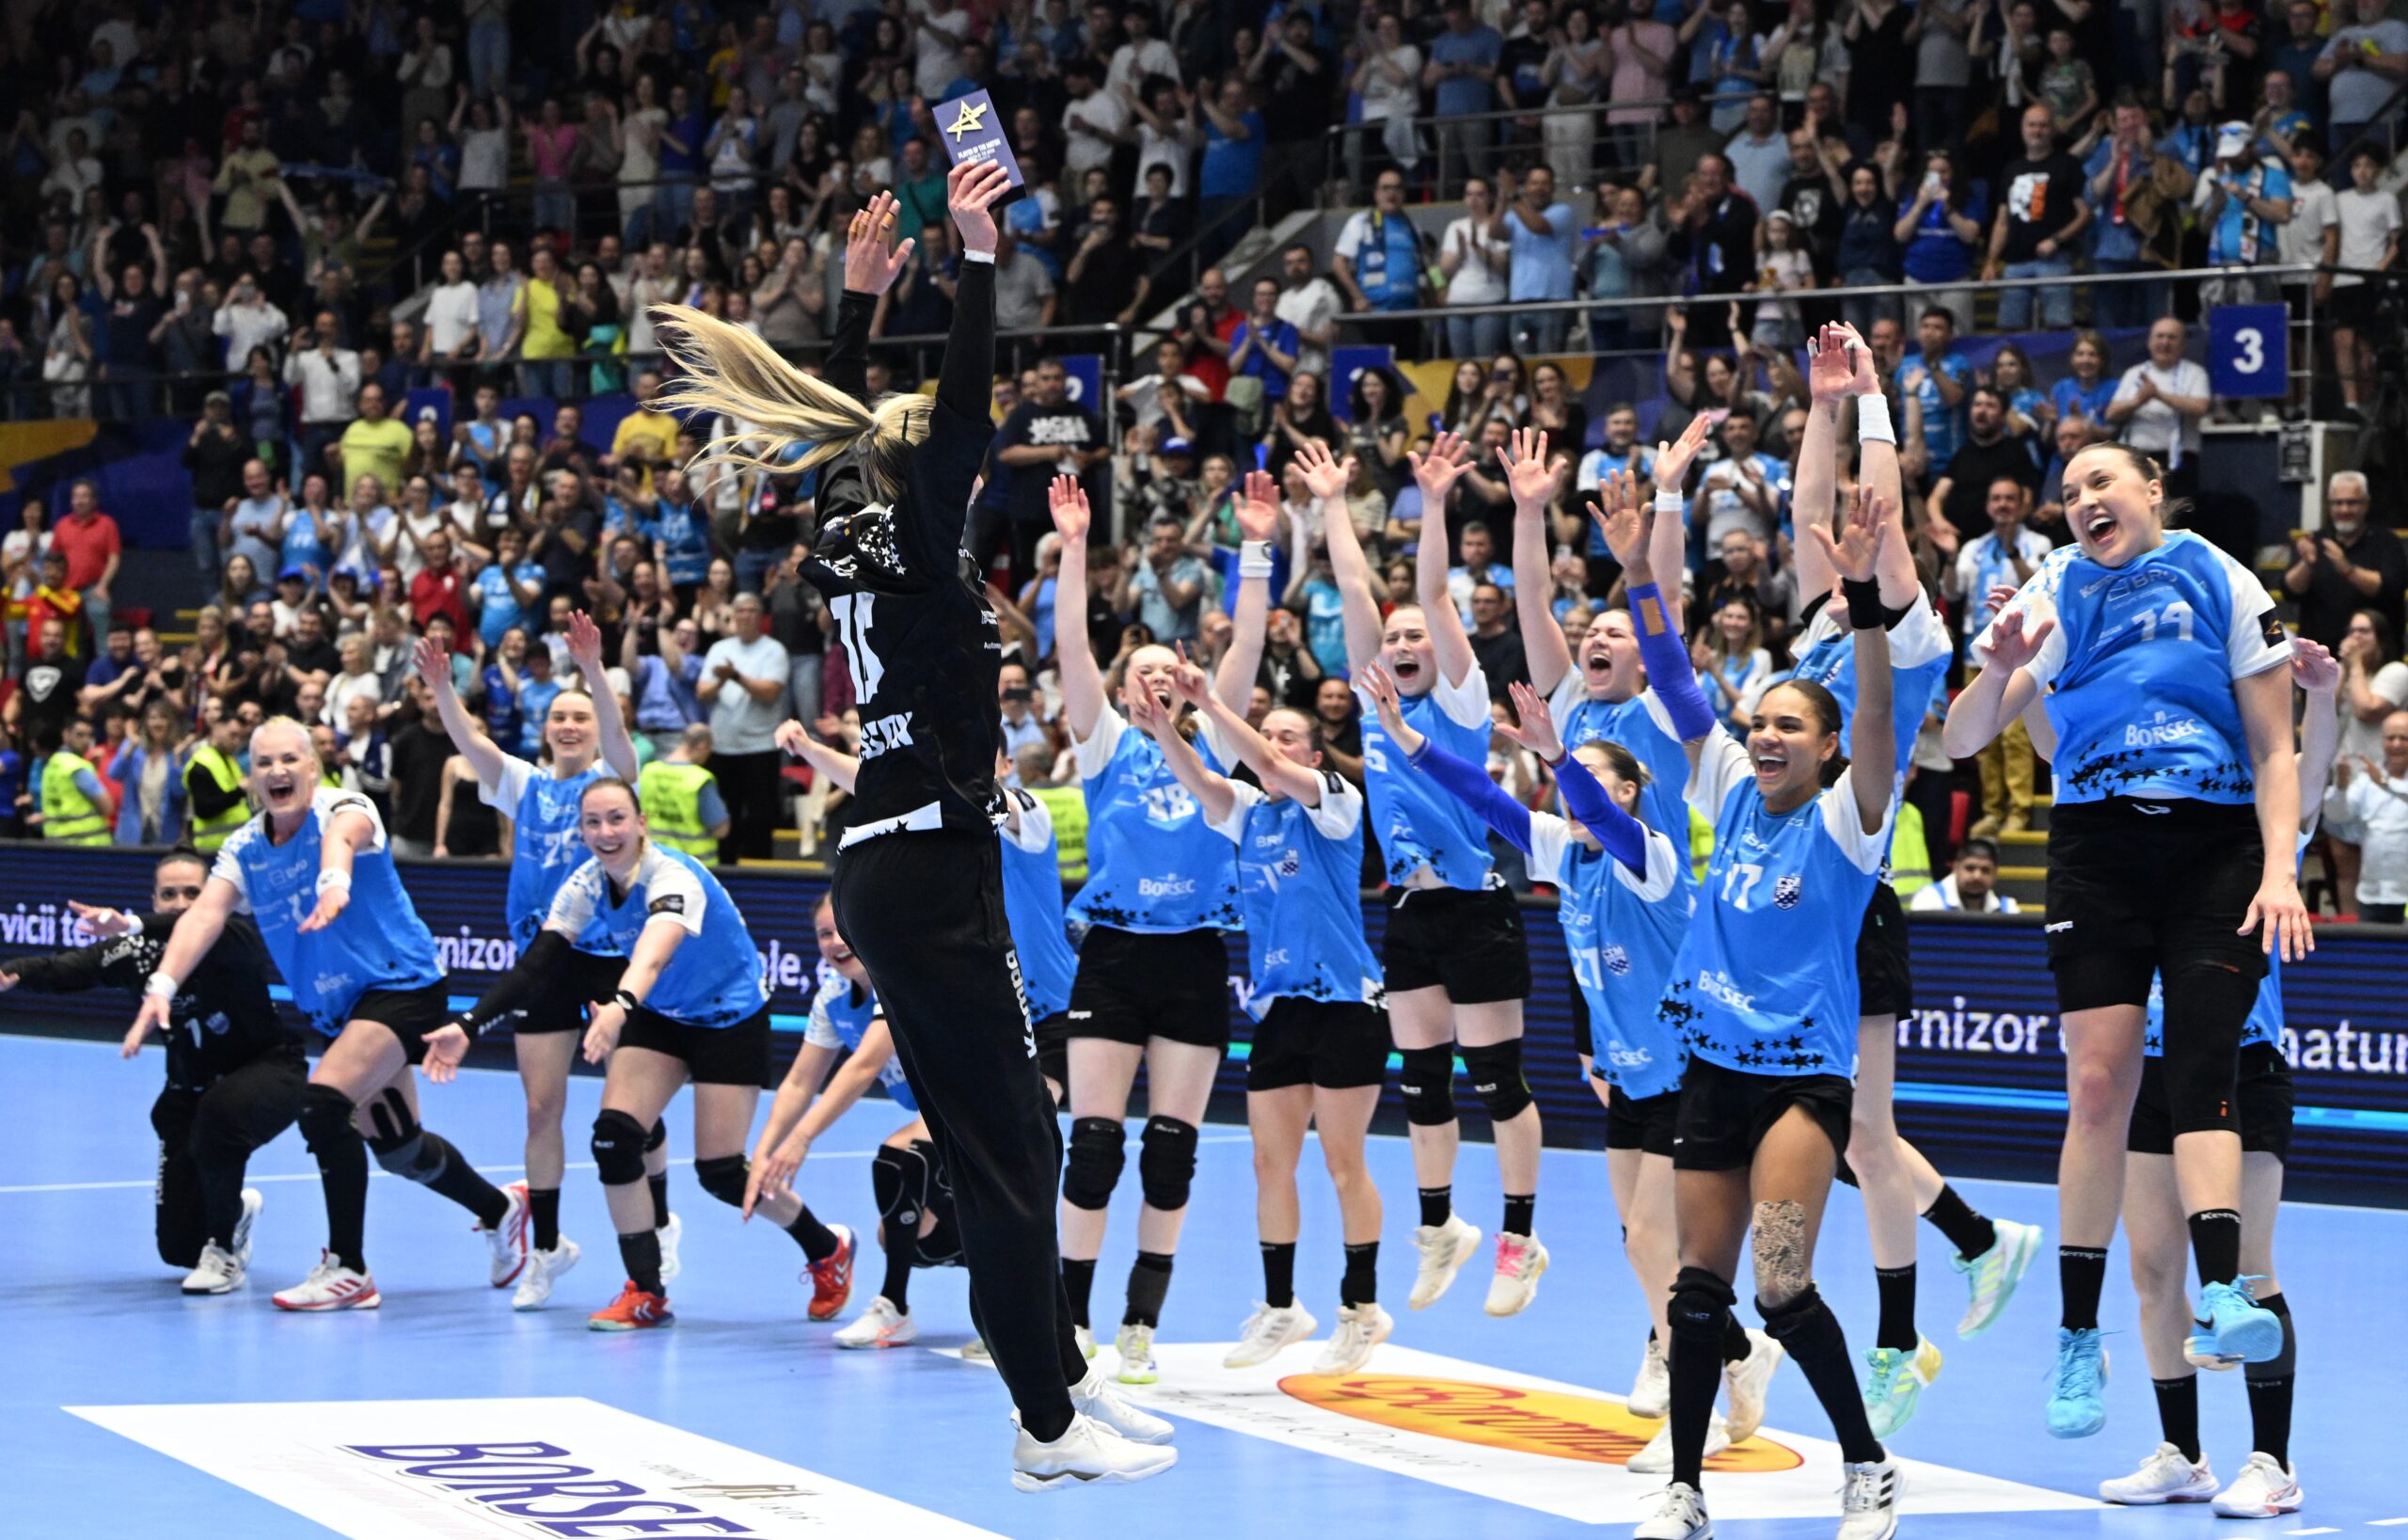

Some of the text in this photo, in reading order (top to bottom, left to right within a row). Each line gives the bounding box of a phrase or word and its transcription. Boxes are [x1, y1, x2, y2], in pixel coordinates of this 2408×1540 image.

[2233, 327, 2264, 373] 3
[2124, 718, 2205, 747] BORSEC
[1138, 877, 1196, 897] BORSEC
[1720, 863, 1765, 911] 17
[1698, 969, 1756, 1013] BRSEC
[184, 1017, 202, 1050] 1
[1330, 1380, 1660, 1459] Boromi
[339, 1441, 769, 1540] BORSE
